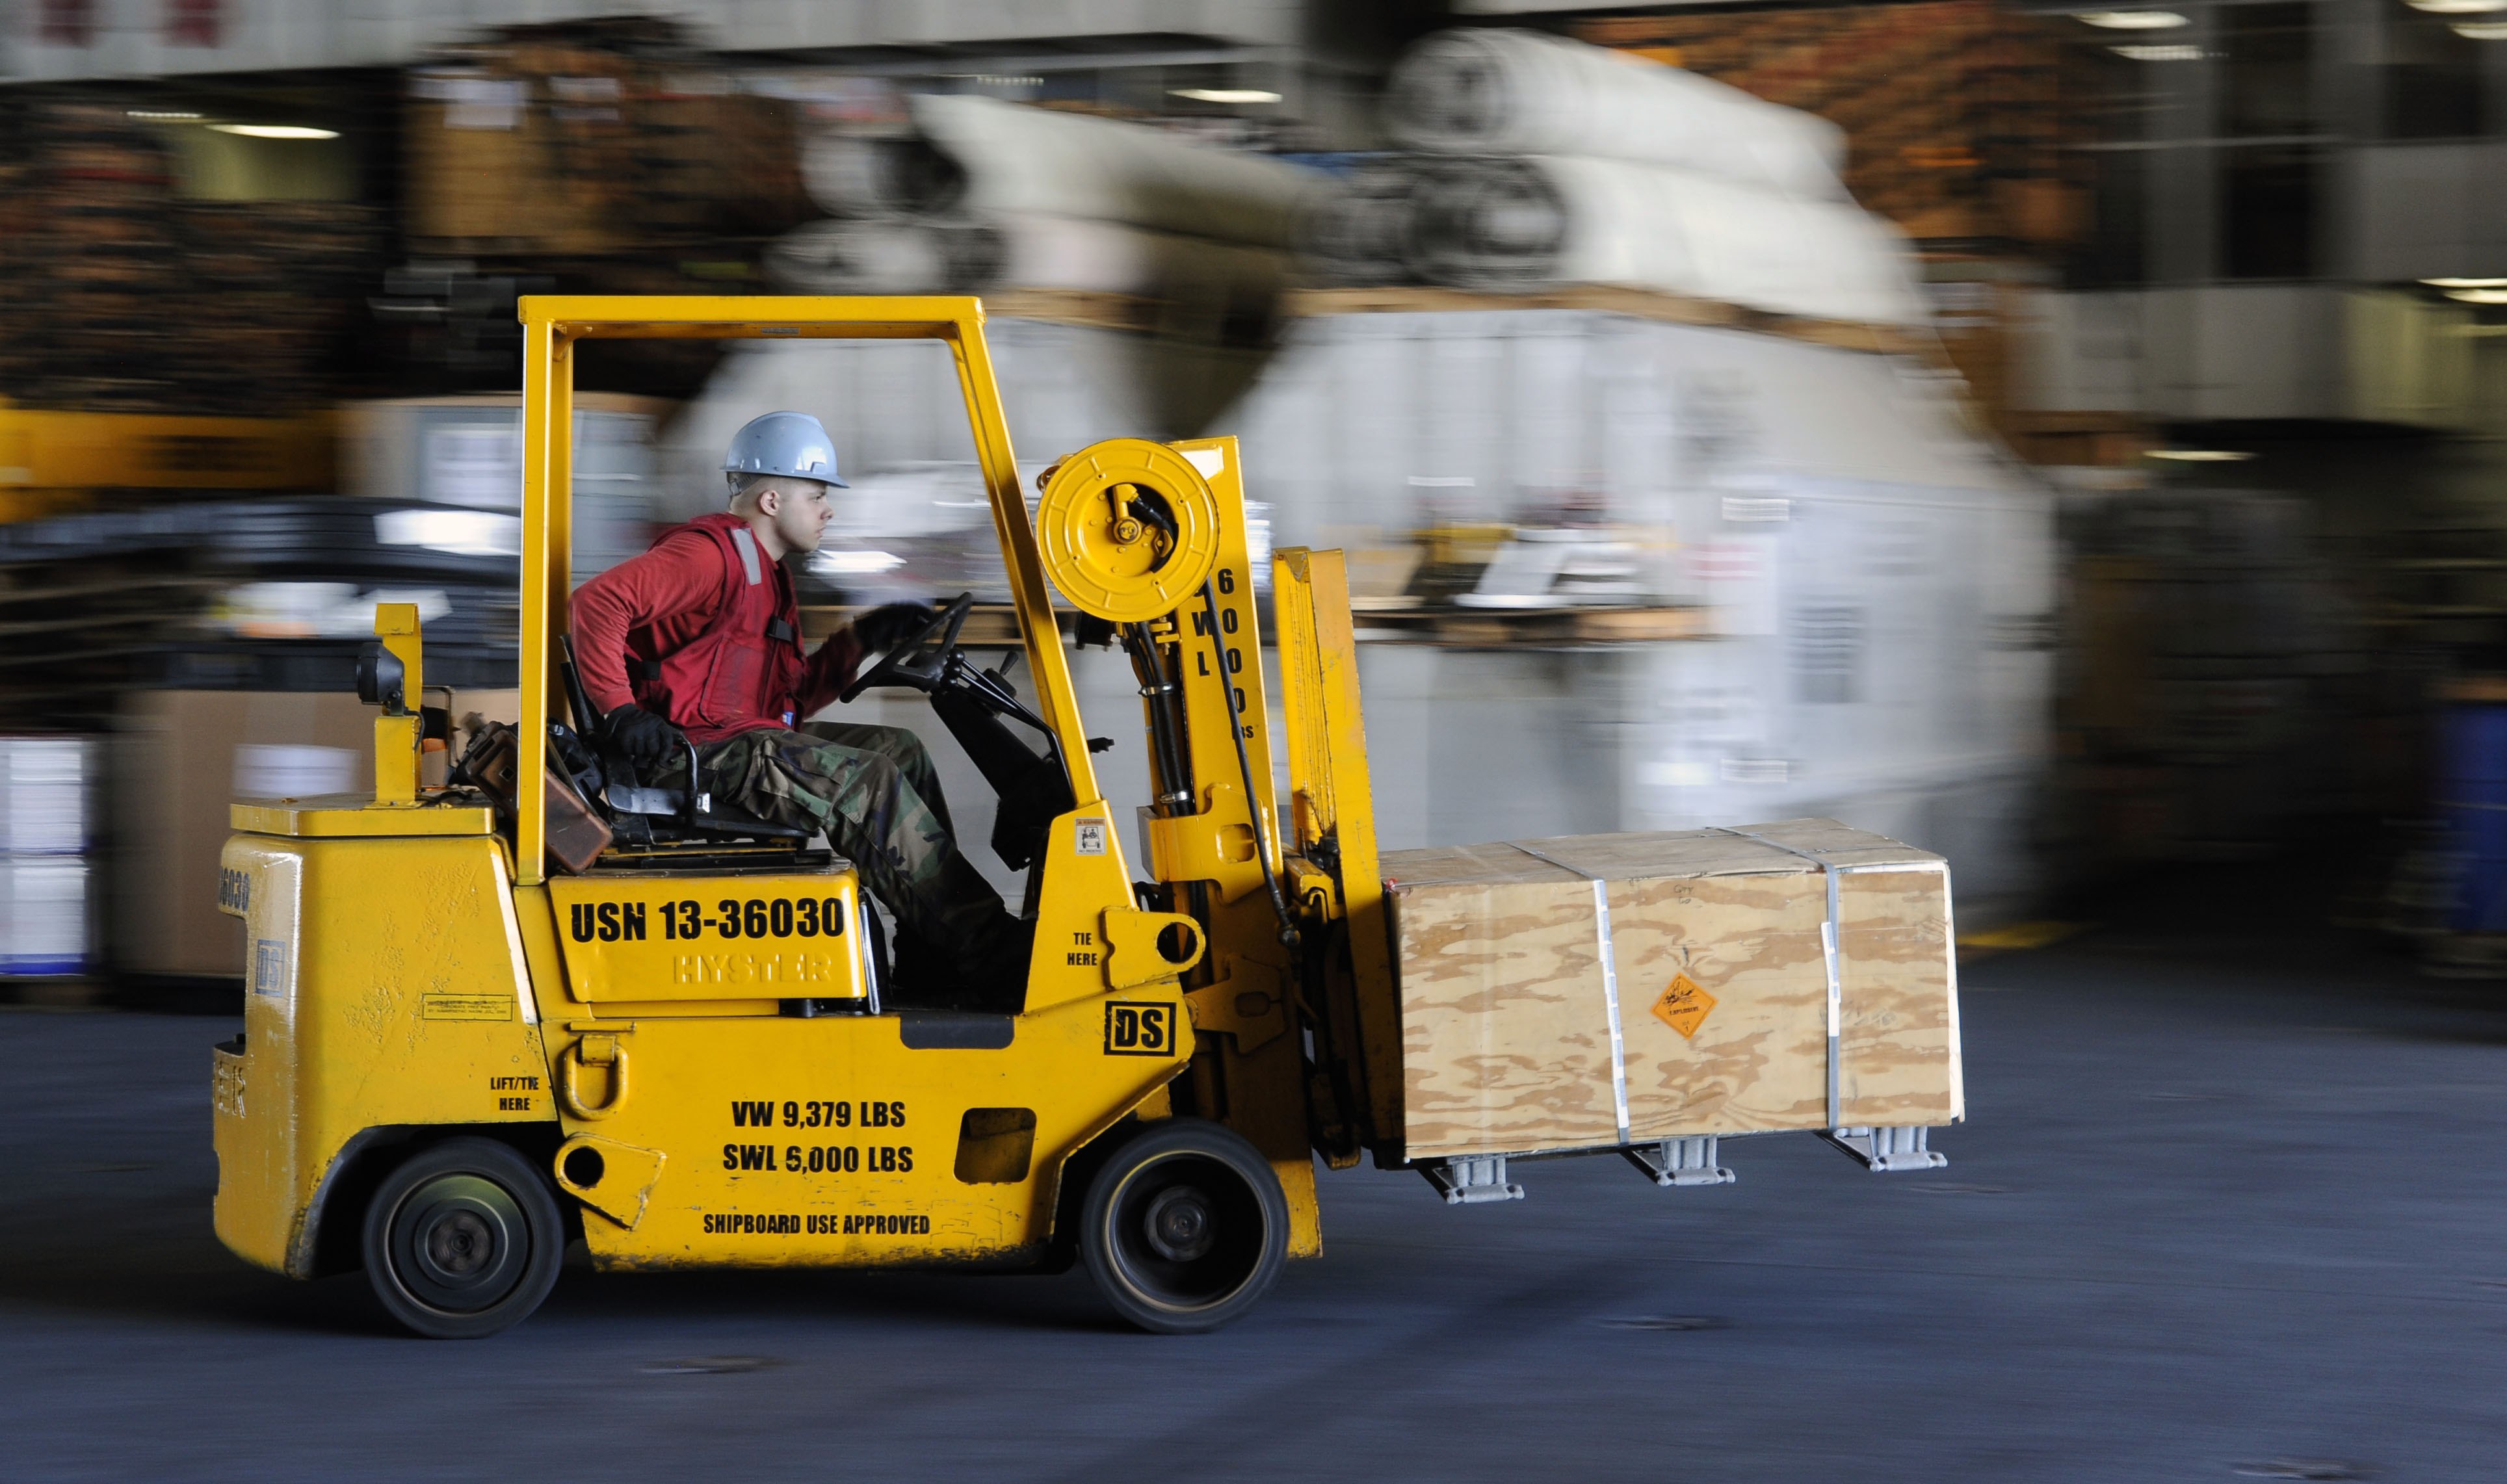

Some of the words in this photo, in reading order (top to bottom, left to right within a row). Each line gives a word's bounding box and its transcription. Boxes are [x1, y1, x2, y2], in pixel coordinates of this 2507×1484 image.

[571, 902, 646, 943] USN
[659, 897, 844, 940] 13-36030
[1073, 932, 1092, 945] TIE
[674, 952, 832, 984] HYSTER
[1067, 952, 1097, 966] HERE
[1114, 1009, 1163, 1048] DS
[490, 1076, 540, 1091] LIFT/TIE
[499, 1097, 530, 1111] HERE
[731, 1101, 775, 1127] VW
[783, 1100, 851, 1130] 9,379
[860, 1101, 906, 1128] LBS
[723, 1143, 778, 1171] SWL
[785, 1145, 860, 1175] 6,000
[868, 1146, 913, 1173] LBS
[703, 1214, 800, 1234] SHIPBOARD
[807, 1214, 838, 1234] USE
[843, 1215, 930, 1234] APPROVED
